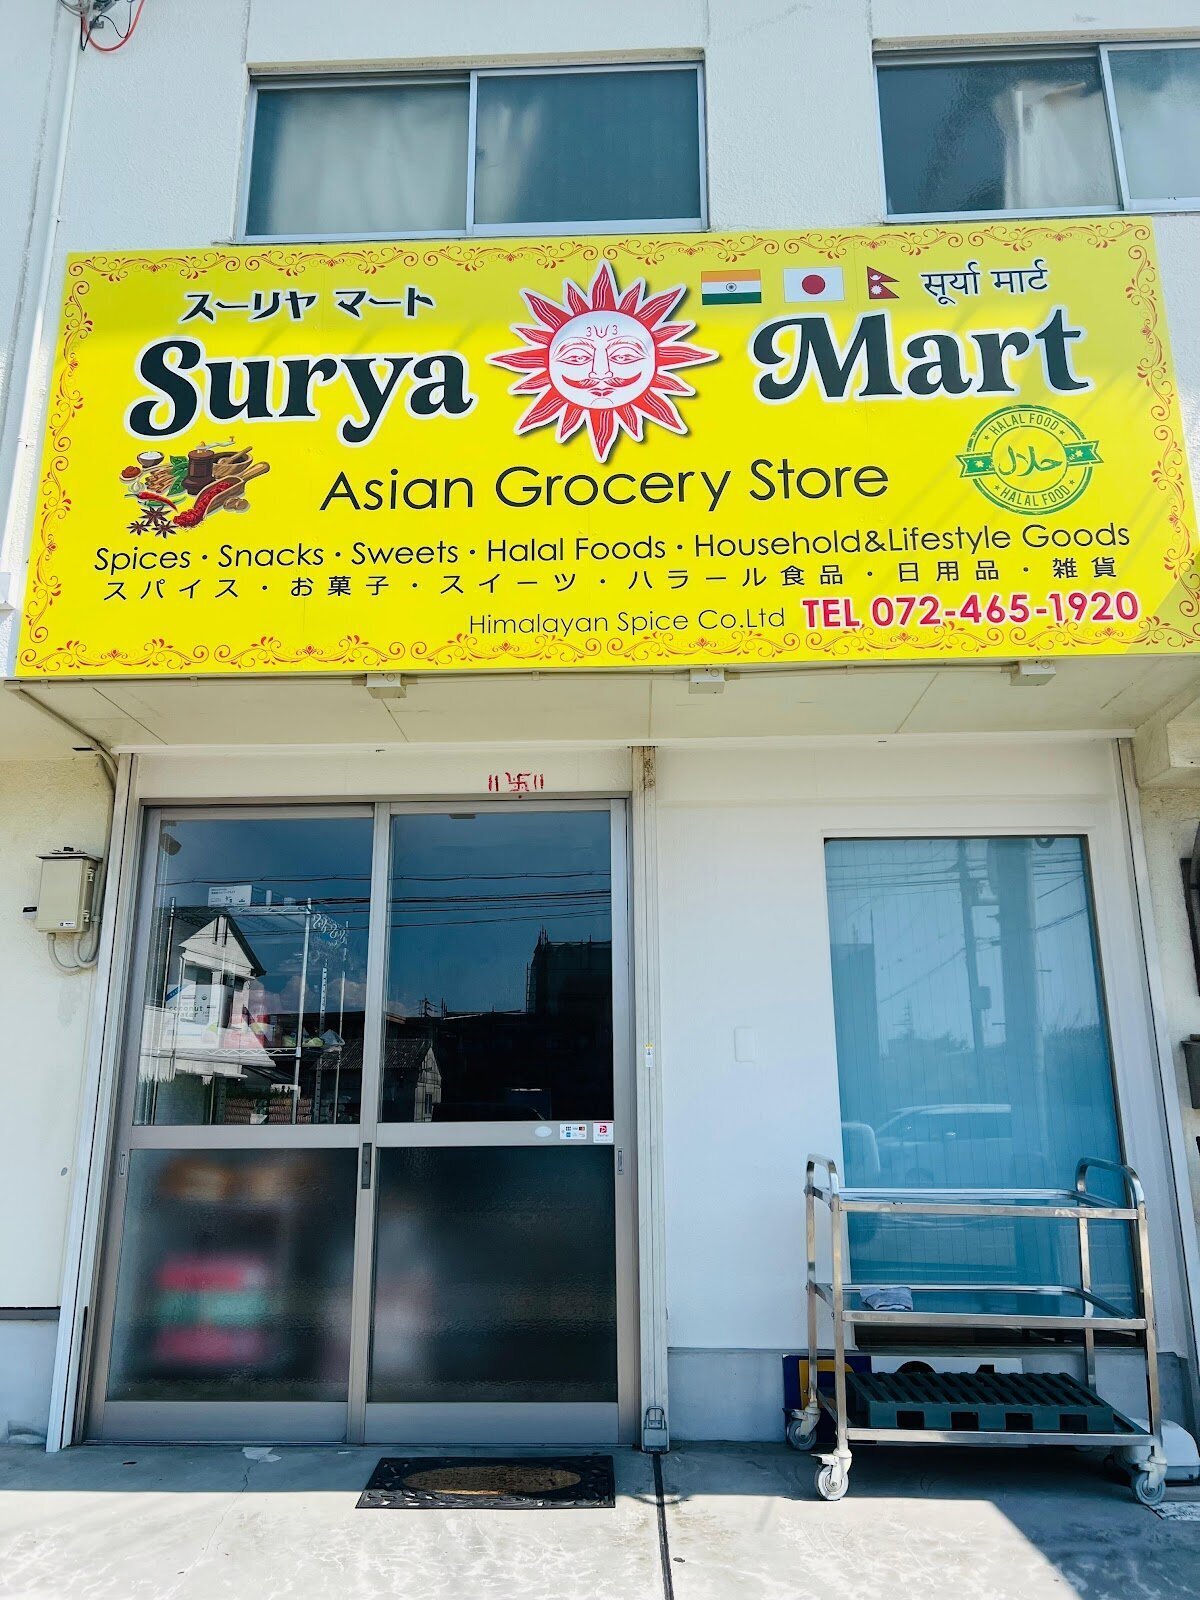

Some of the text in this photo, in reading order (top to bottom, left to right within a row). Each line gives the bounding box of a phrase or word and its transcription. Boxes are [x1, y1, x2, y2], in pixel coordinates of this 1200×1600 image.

[921, 258, 1049, 305] सूर्या मार्ट
[182, 287, 435, 322] スーリヤ マート
[129, 308, 1089, 443] Surya Mart
[988, 413, 1060, 436] HALAL FOOD
[998, 445, 1063, 477] حلال
[320, 458, 889, 512] Asian Grocery Store
[1000, 484, 1071, 507] HALAL FOOD
[94, 522, 1130, 575] Spices Snacks Sweets Halal Foods Household&Lifestyle Goods
[103, 578, 239, 601] スパイス
[290, 575, 389, 597] お菓子
[440, 573, 576, 595] スイーツ
[898, 559, 999, 582] 日用品
[1052, 555, 1117, 579] 雑貨
[470, 607, 785, 637] Himalayan Spice Co.Ltd
[802, 590, 1139, 628] TEL 072-465-1920
